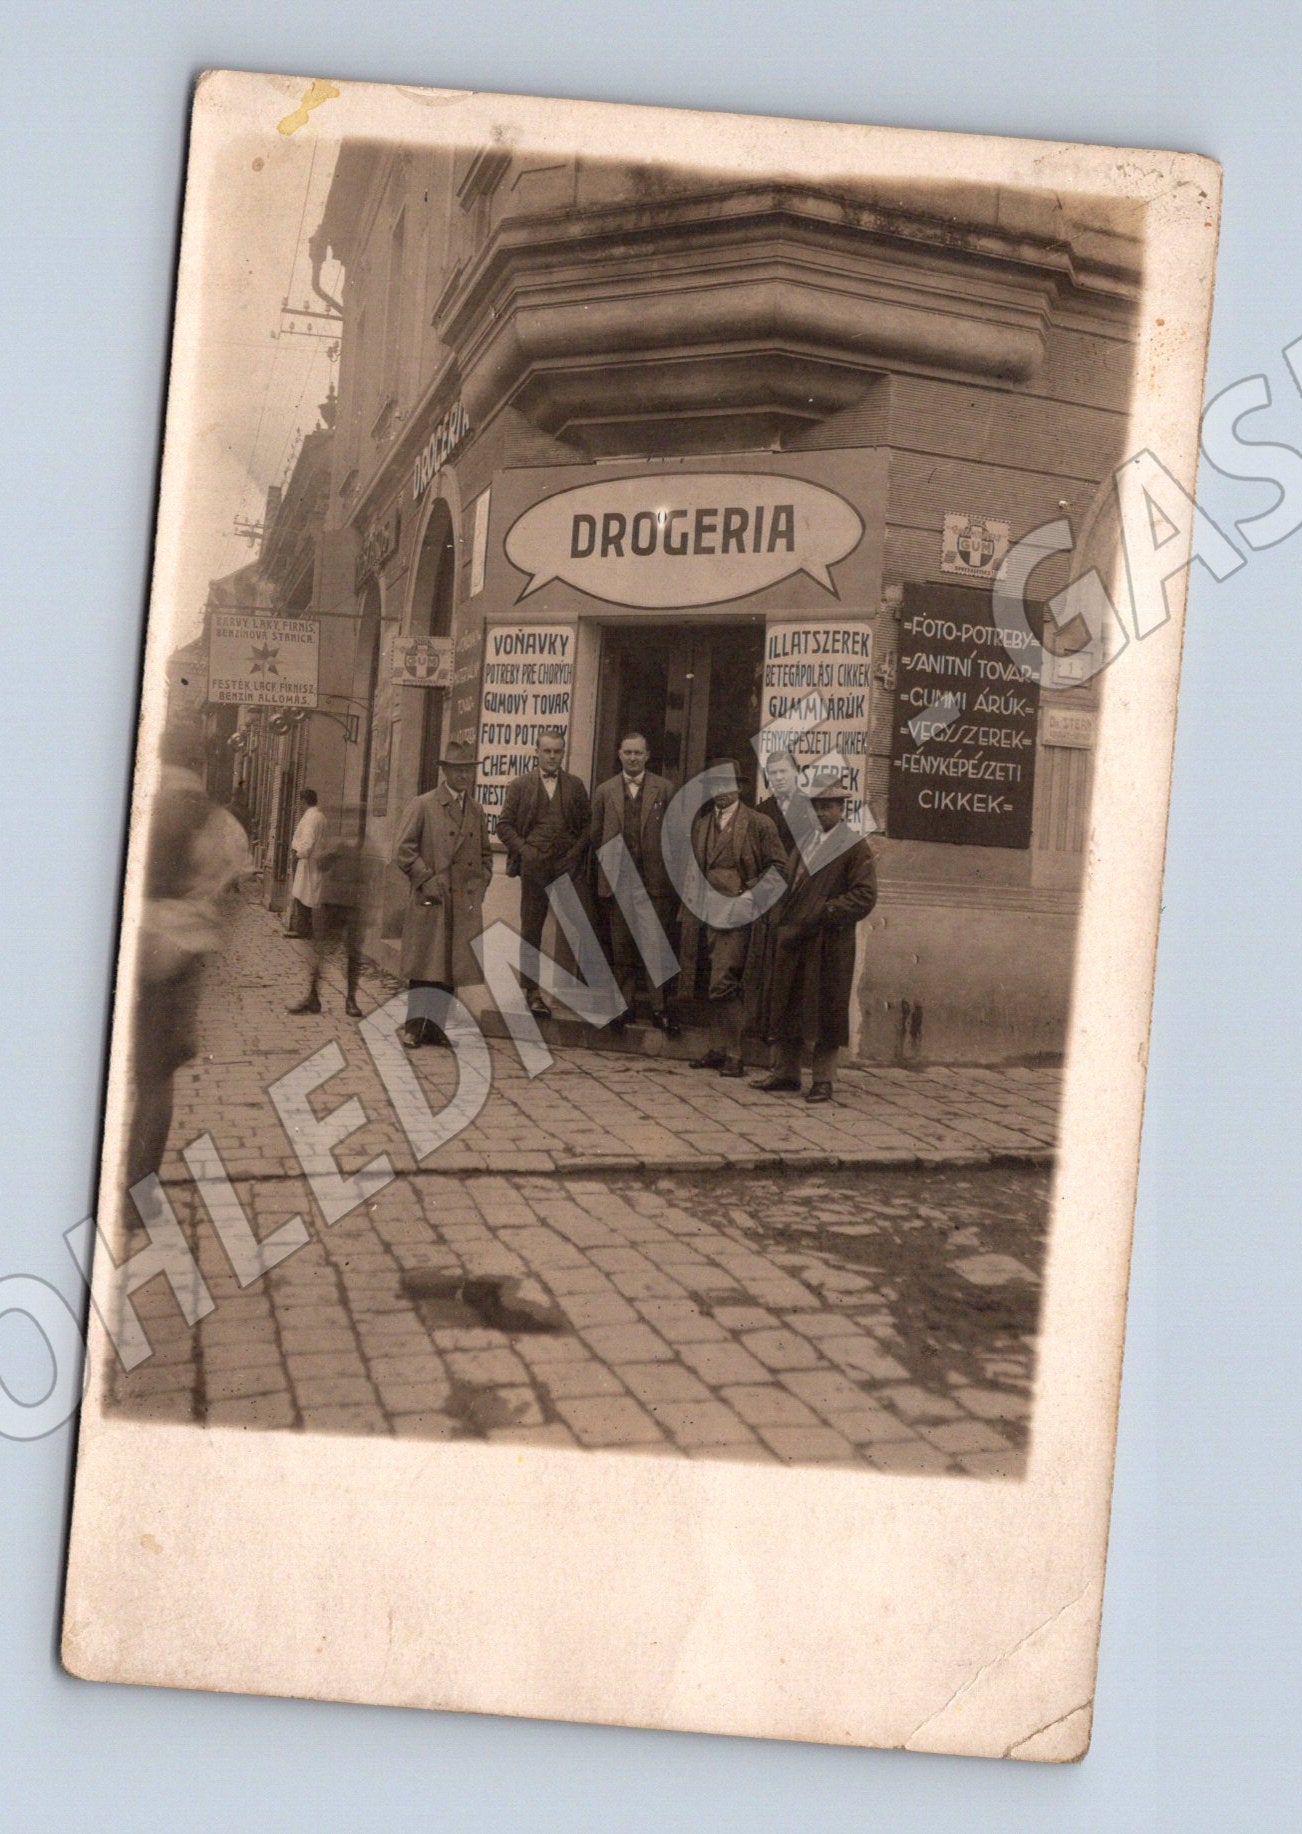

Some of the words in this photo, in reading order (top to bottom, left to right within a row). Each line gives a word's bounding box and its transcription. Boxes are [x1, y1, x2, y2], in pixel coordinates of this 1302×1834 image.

[570, 505, 795, 558] DROGERIA
[961, 539, 992, 555] GUM
[494, 629, 569, 657] VOŇAVKY
[769, 630, 870, 660] ILLATSZEREK
[485, 663, 520, 685] POTREBY
[521, 663, 538, 685] PRE
[538, 660, 573, 685] CHORÝCH
[765, 661, 834, 688] BETEGÁPOLÁSI
[837, 664, 871, 688] CIKKEK
[484, 689, 528, 715] GUMOVÝ
[532, 692, 569, 715] TOVAR
[769, 695, 823, 720] GUMMI
[827, 692, 865, 721] ÁRÚK
[481, 723, 511, 744] FOTO
[836, 731, 868, 755] CIKKEK
